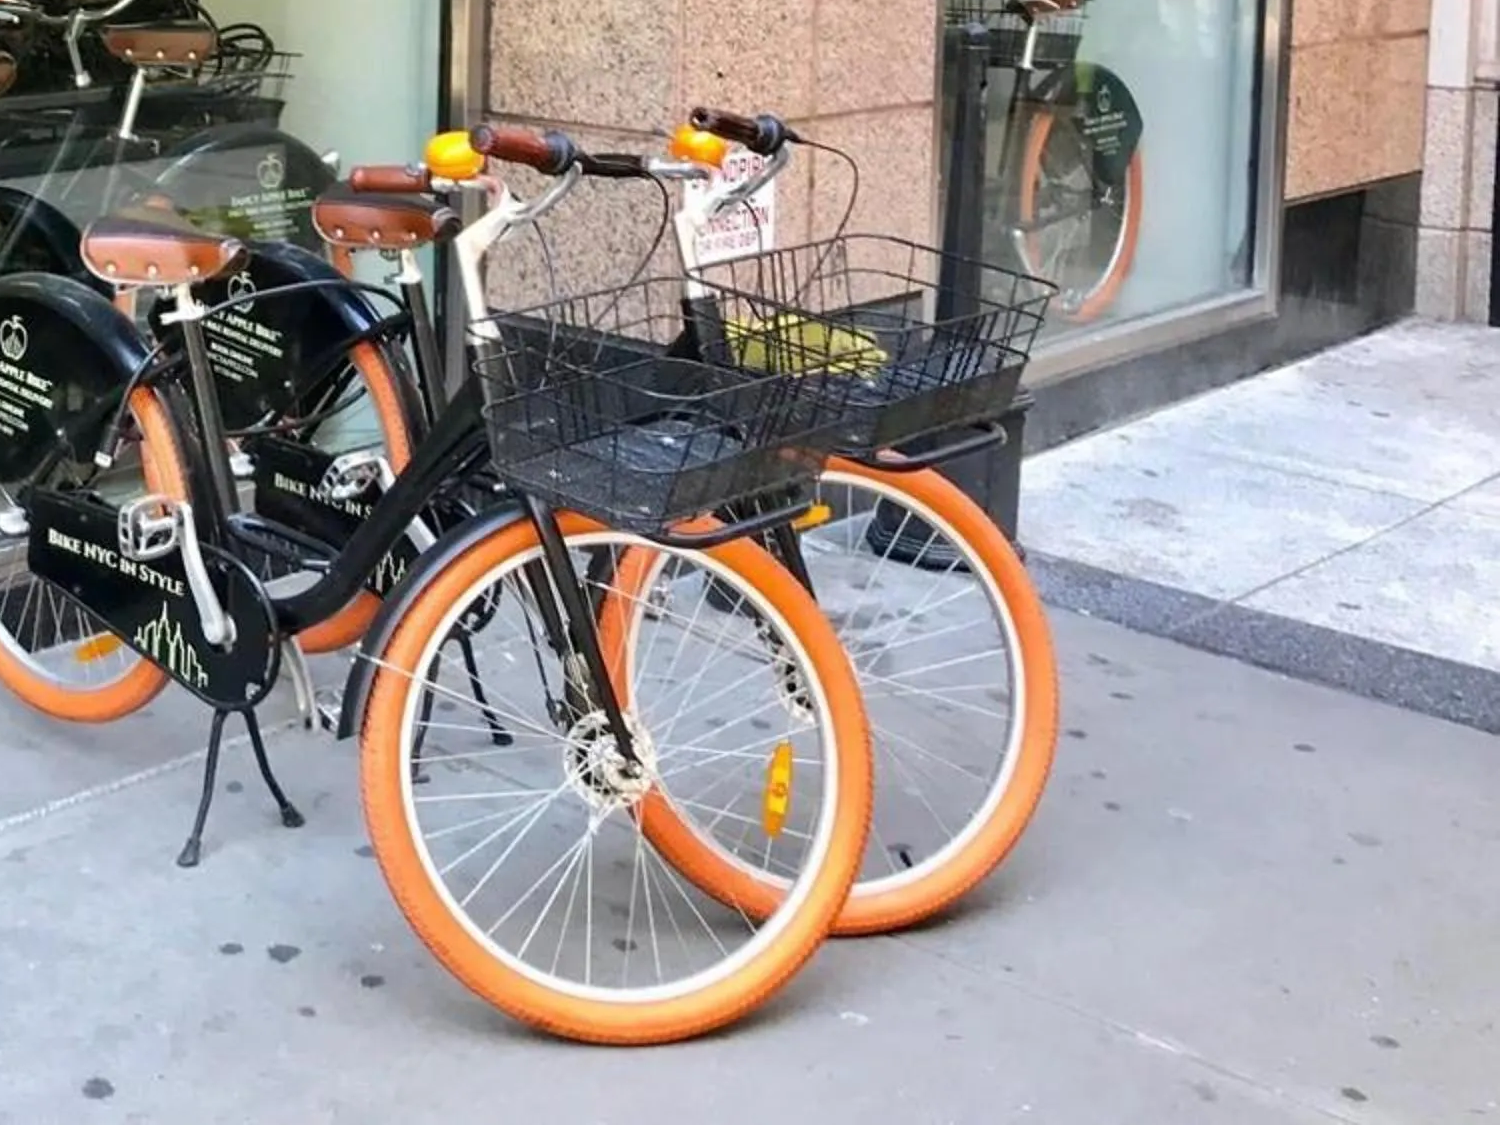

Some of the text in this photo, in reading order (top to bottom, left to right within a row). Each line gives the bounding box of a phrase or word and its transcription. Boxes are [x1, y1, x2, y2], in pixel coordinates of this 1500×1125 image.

[274, 472, 308, 497] BIKE
[48, 527, 185, 596] BIKE NYC IN STYLE
